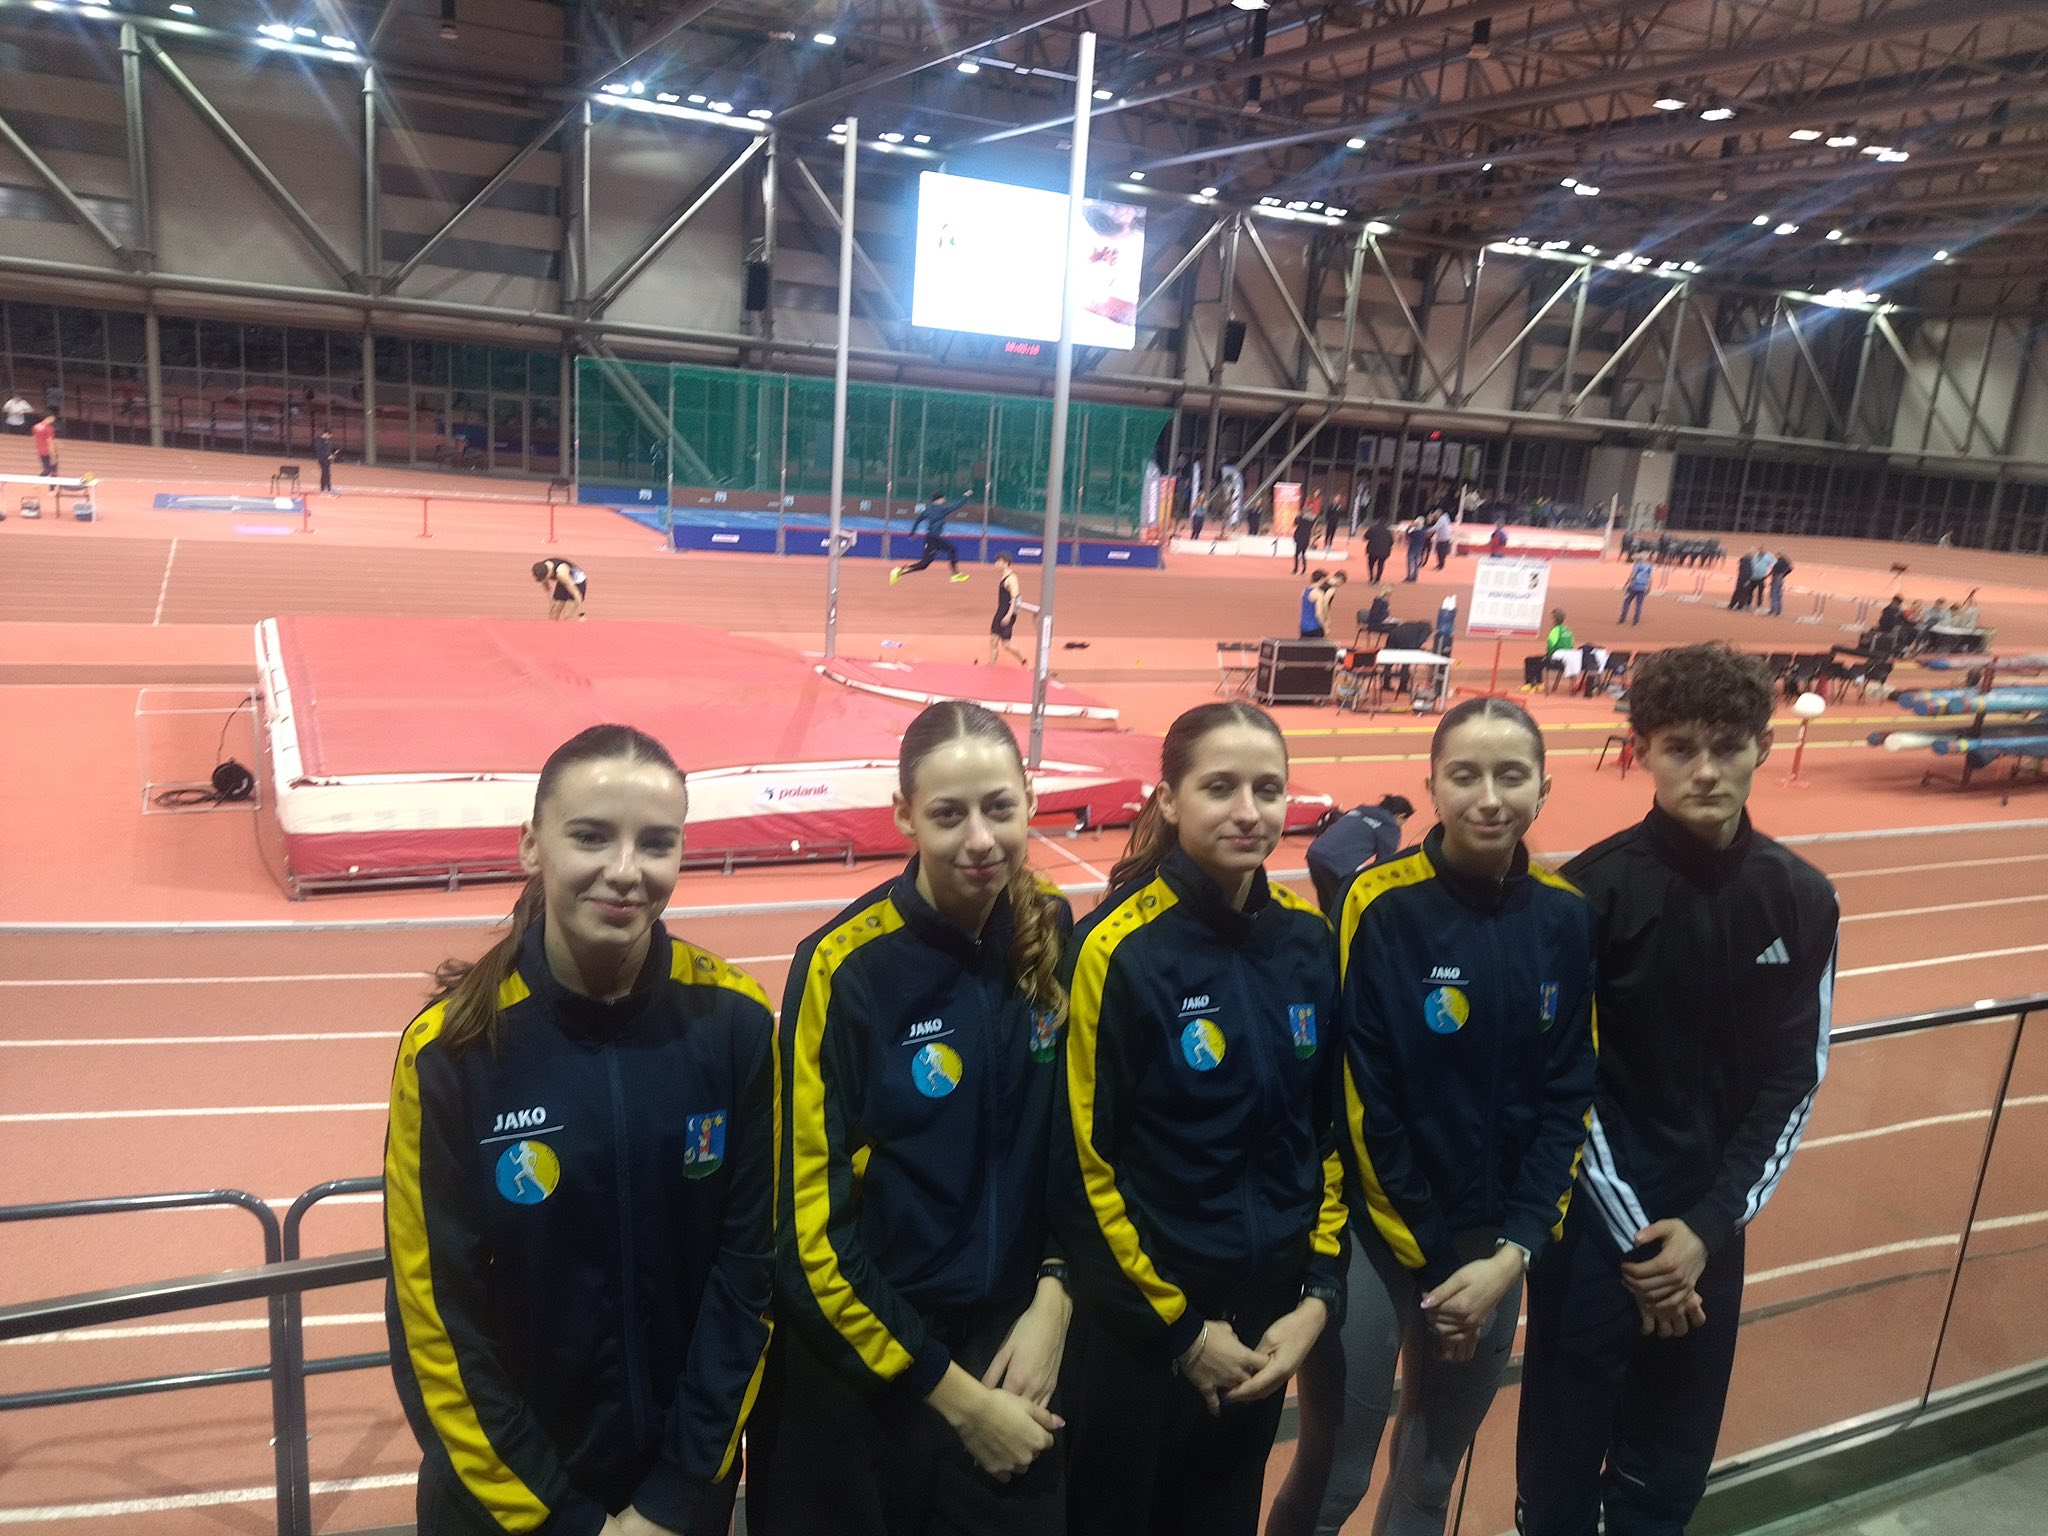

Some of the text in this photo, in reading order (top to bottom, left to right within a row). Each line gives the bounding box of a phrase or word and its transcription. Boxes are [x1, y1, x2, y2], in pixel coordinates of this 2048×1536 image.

[778, 783, 829, 801] polanik
[1430, 965, 1461, 980] JAKO
[1181, 994, 1210, 1011] JAKO
[909, 1017, 943, 1038] JAKO
[493, 1106, 547, 1133] JAKO
